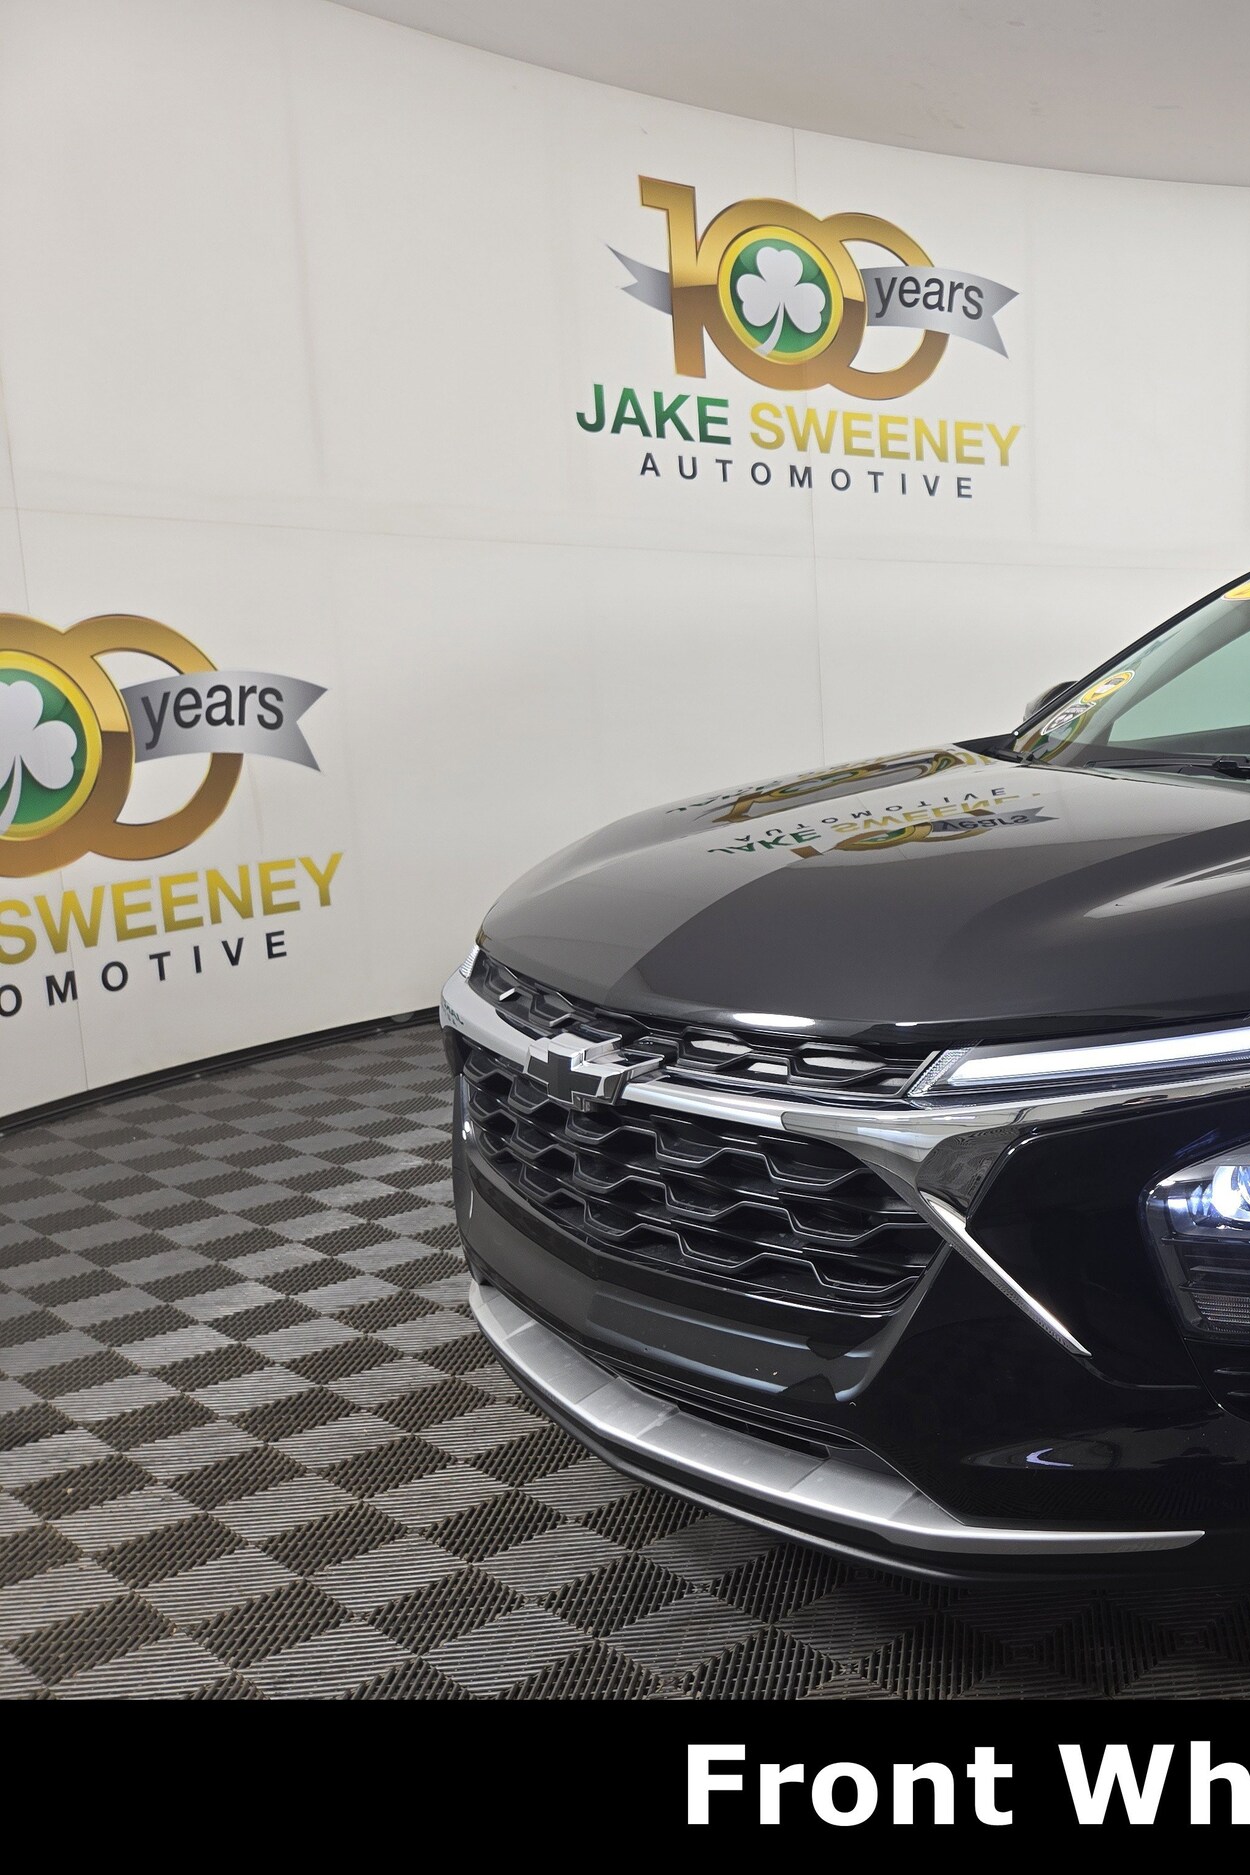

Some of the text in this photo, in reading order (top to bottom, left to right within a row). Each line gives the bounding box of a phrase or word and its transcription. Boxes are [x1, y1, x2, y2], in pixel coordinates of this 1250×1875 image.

[875, 274, 984, 320] years
[576, 384, 1021, 466] JAKE SWEENEY
[640, 452, 973, 498] AUTOMOTIVE
[141, 684, 285, 750] years
[0, 852, 343, 965] SWEENEY
[0, 930, 287, 1017] OMOTIVE
